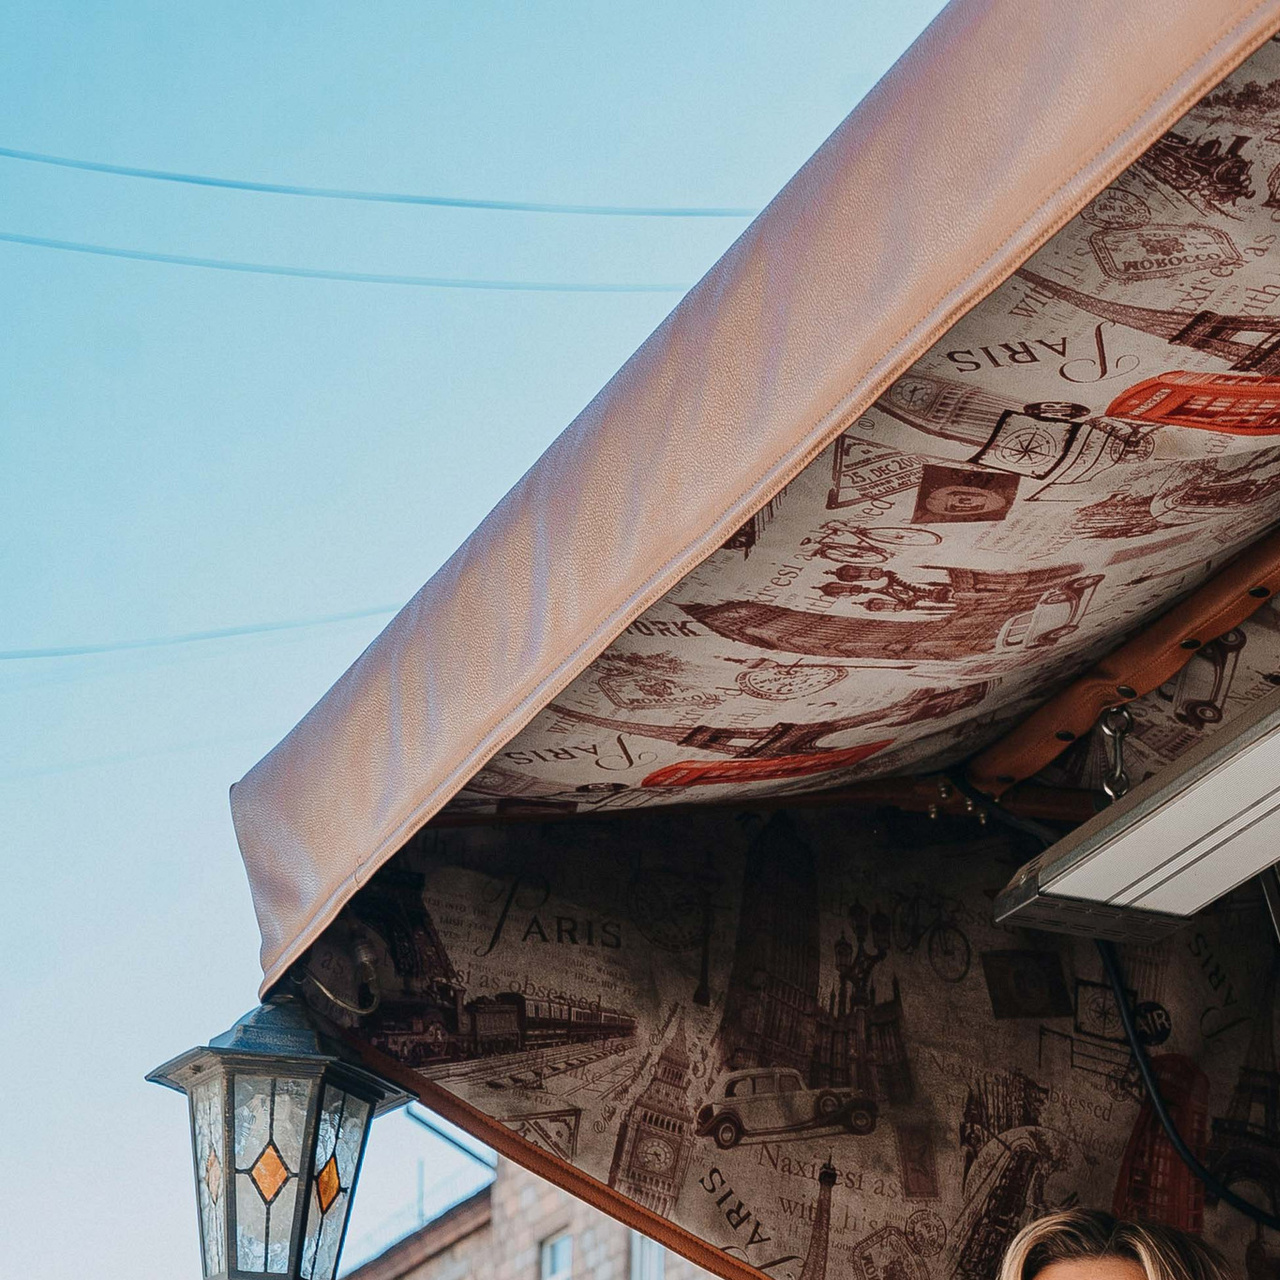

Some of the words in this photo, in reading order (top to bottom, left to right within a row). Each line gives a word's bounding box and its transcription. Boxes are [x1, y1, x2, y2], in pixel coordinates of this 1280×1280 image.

[1121, 252, 1221, 272] MOROCCO
[1008, 284, 1056, 318] wit
[946, 320, 1141, 384] PARIS
[869, 463, 897, 478] DEC
[505, 732, 658, 771] PARIS
[474, 872, 622, 957] PARIS
[509, 974, 602, 1012] obsessed
[1136, 1008, 1171, 1034] AIR
[759, 1143, 865, 1191] Naxiesi
[874, 1177, 898, 1199] as
[778, 1195, 822, 1222] wit
